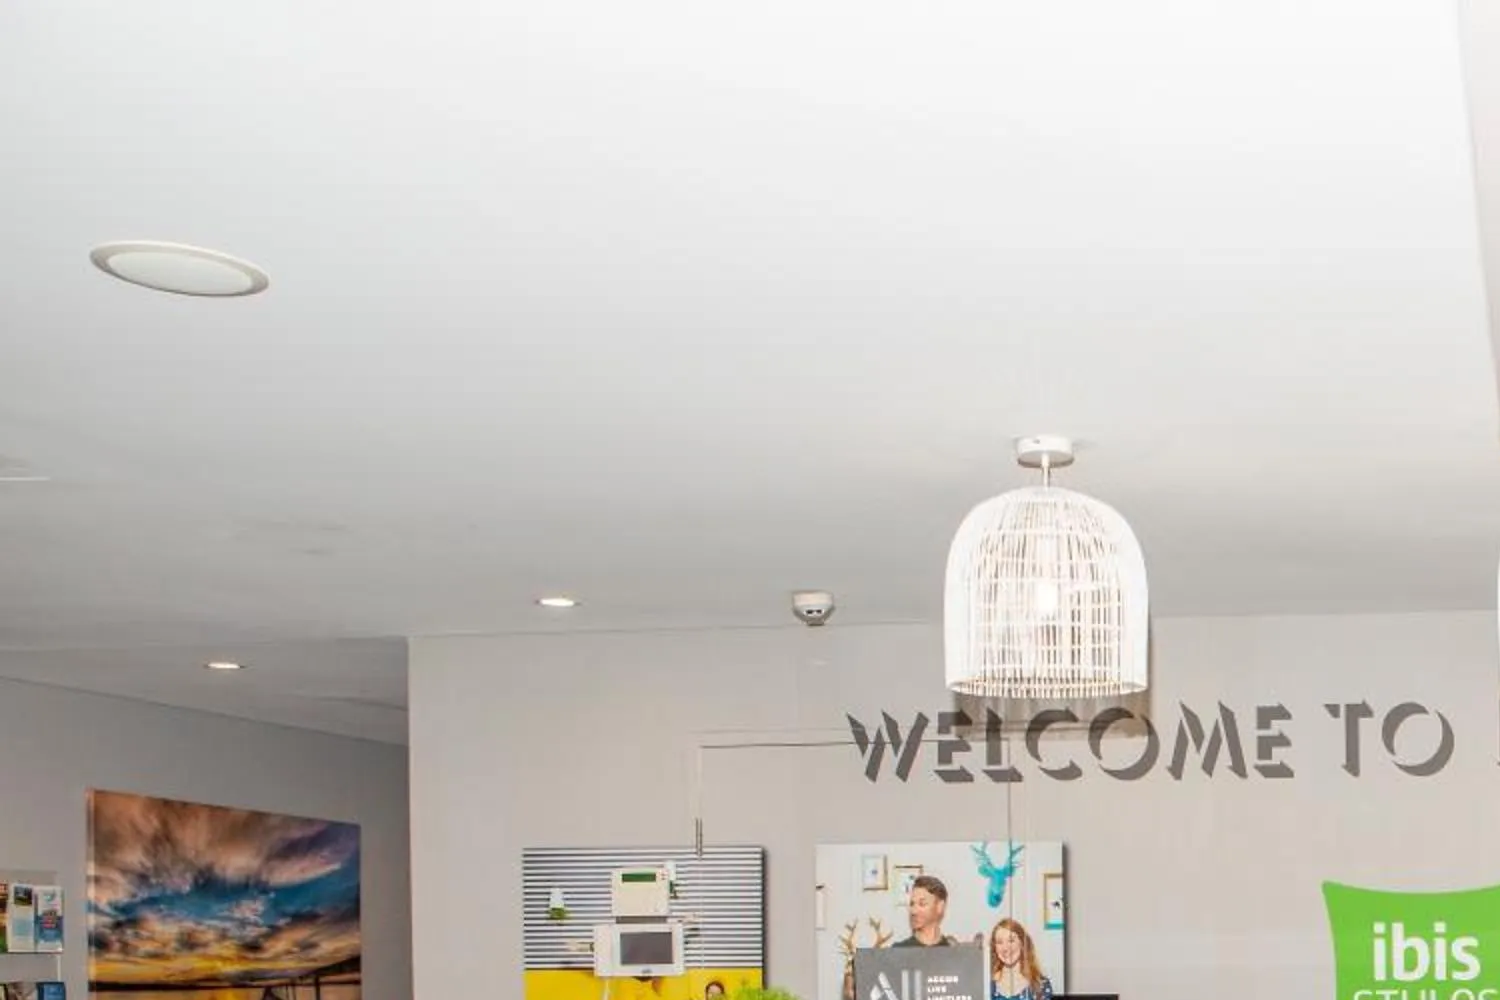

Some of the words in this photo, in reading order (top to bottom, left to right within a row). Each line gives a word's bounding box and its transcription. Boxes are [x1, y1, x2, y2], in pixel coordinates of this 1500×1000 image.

[845, 700, 1295, 783] WELCOME
[1323, 699, 1455, 778] TO
[1373, 921, 1481, 981] ibis
